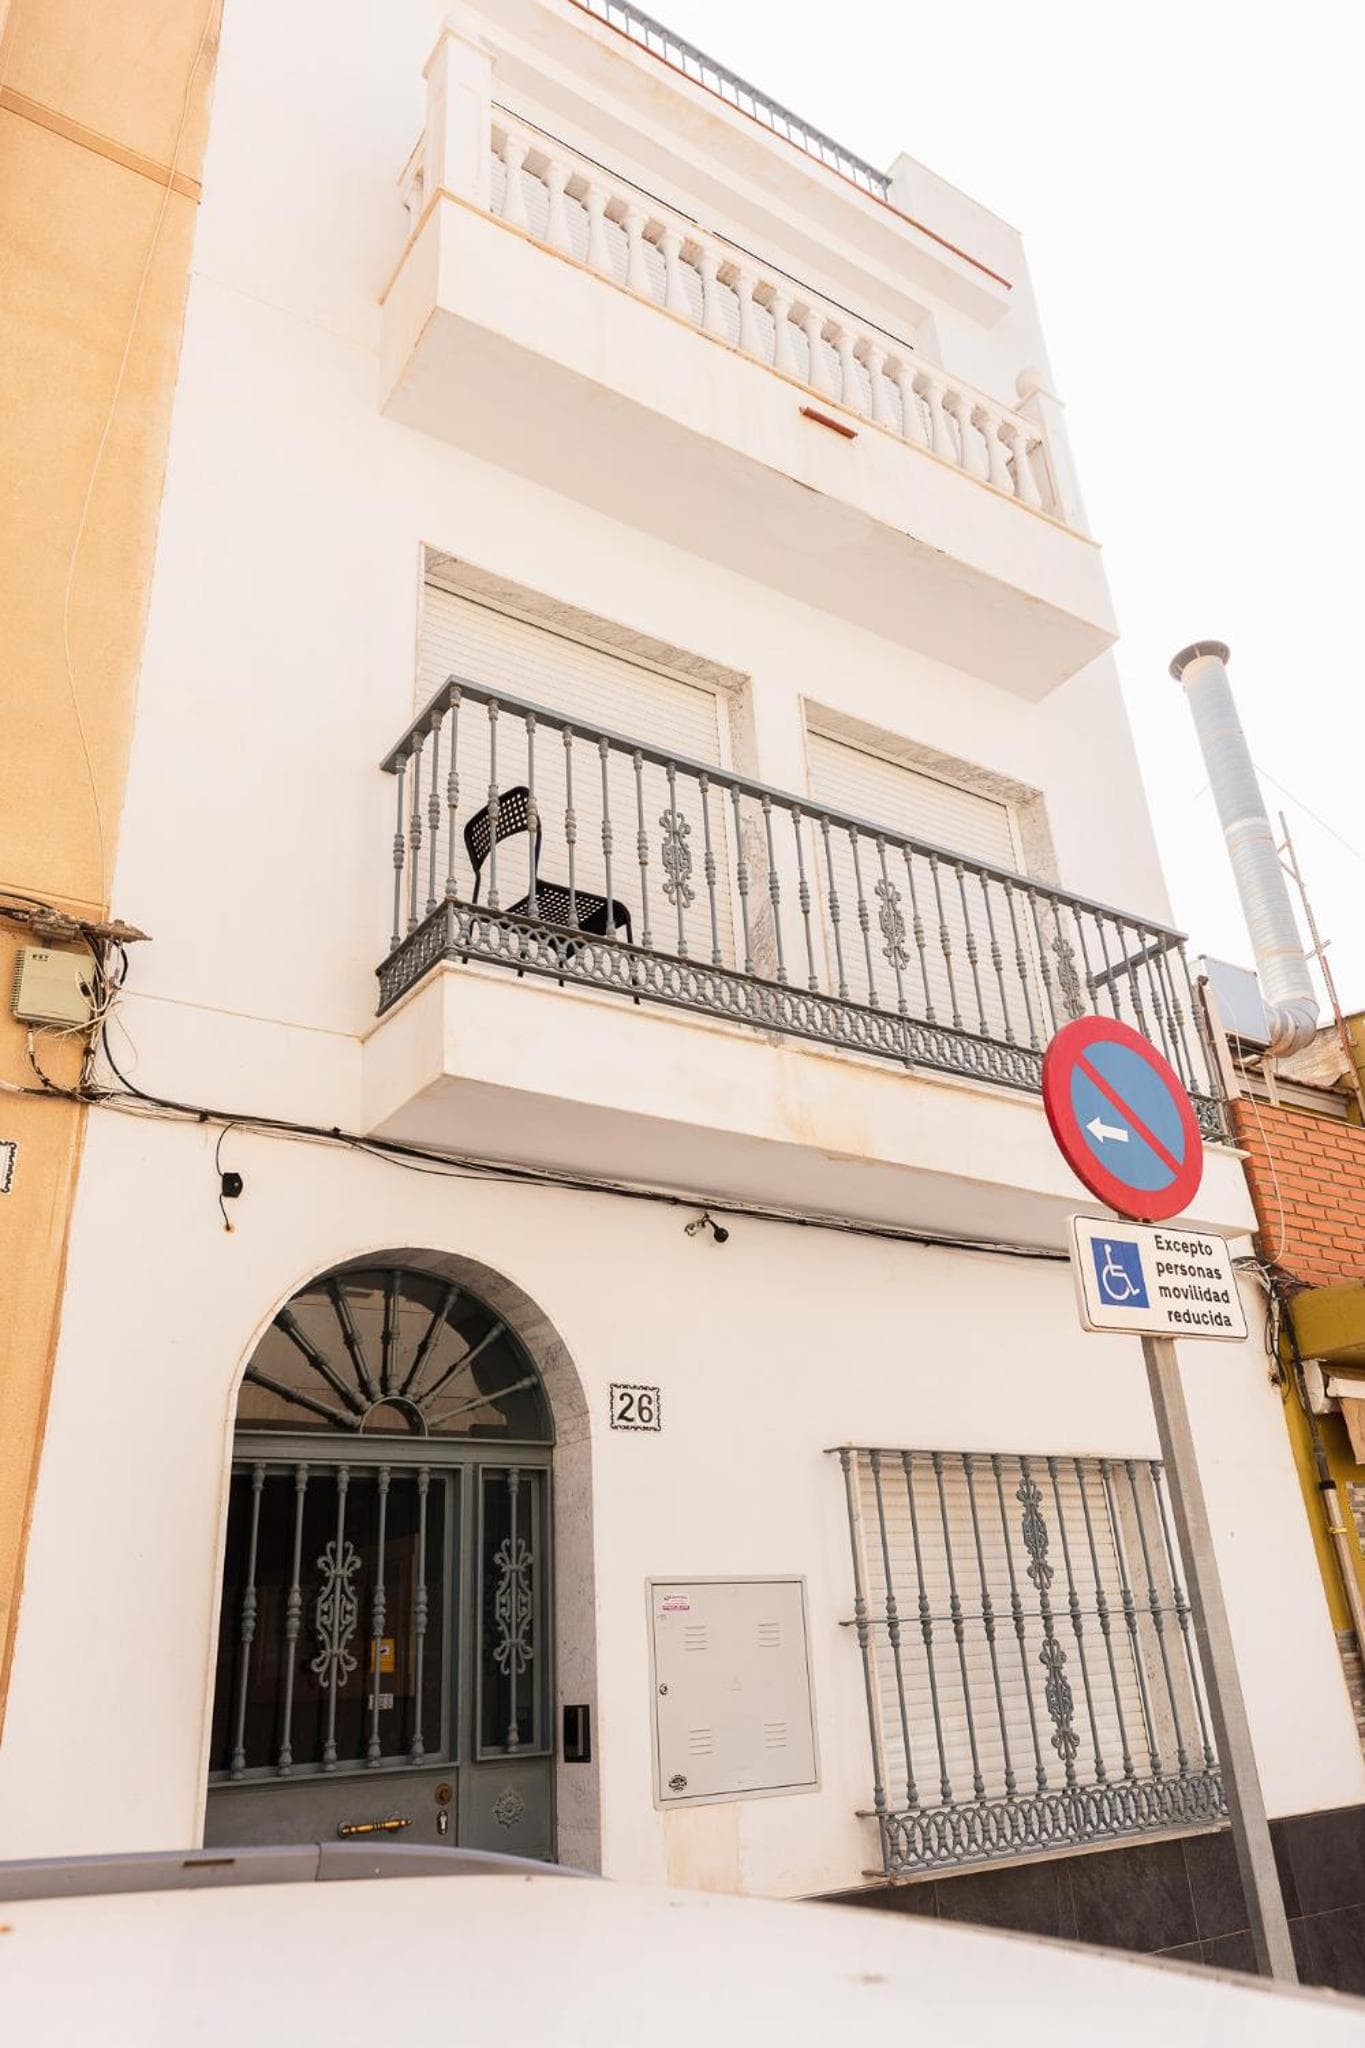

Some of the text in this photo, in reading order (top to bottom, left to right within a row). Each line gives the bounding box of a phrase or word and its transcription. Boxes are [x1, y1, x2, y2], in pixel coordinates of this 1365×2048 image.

[1154, 1235, 1213, 1257] Excepto
[1156, 1261, 1222, 1280] personas
[1158, 1284, 1231, 1304] movilidad
[1167, 1309, 1232, 1327] reducida
[617, 1392, 653, 1423] 26
